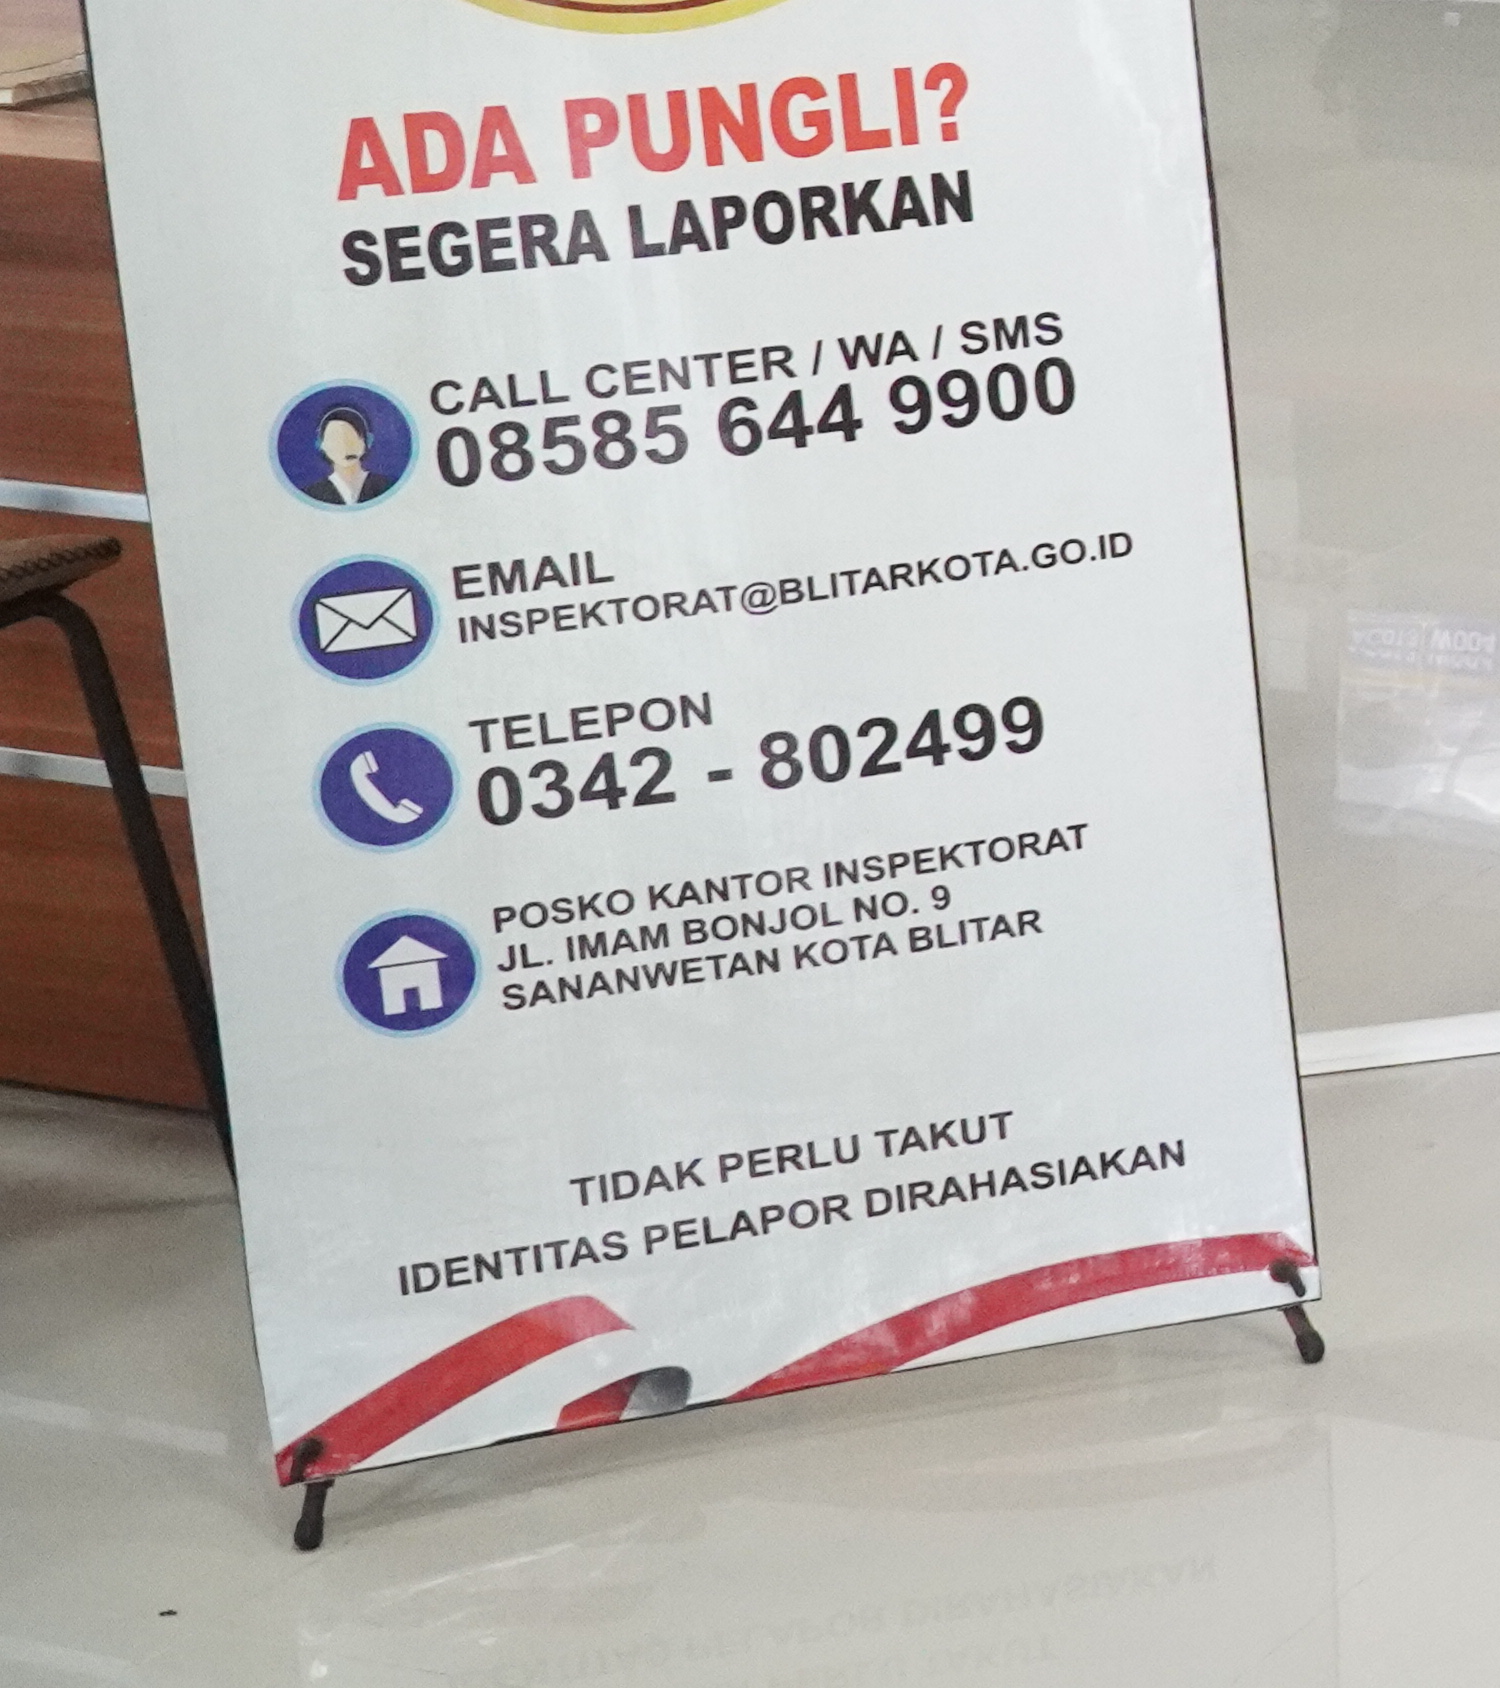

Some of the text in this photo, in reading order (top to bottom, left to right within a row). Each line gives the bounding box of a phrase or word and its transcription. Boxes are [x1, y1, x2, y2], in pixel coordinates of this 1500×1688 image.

[337, 62, 968, 201] ADA PUNGLI?
[342, 169, 973, 287] SEGERA LAPORKAN
[430, 370, 569, 416] CALL
[585, 345, 797, 399] CENTER
[837, 330, 919, 371] WA
[960, 311, 1063, 355] SMS
[436, 356, 1075, 488] 08585 644 9900
[452, 551, 614, 600] EMAIL
[452, 532, 1133, 644] INSPEKTORAT@BLITARKOTA.GO.ID
[468, 692, 712, 754] TELEPON
[477, 746, 676, 826] 0342
[760, 696, 1044, 790] 802499
[493, 823, 1088, 934] POSKO KANTOR INSPEKTORAT
[497, 884, 951, 972] JL. IMAM BONJOL NO. 9
[502, 908, 1043, 1012] SANANWETAN KOTA BLITAR
[569, 1110, 1013, 1206] TIDAK PERLU TAKUT
[398, 1139, 1186, 1296] IDENTITAS PELAPOR DIRAHASIAKAN
